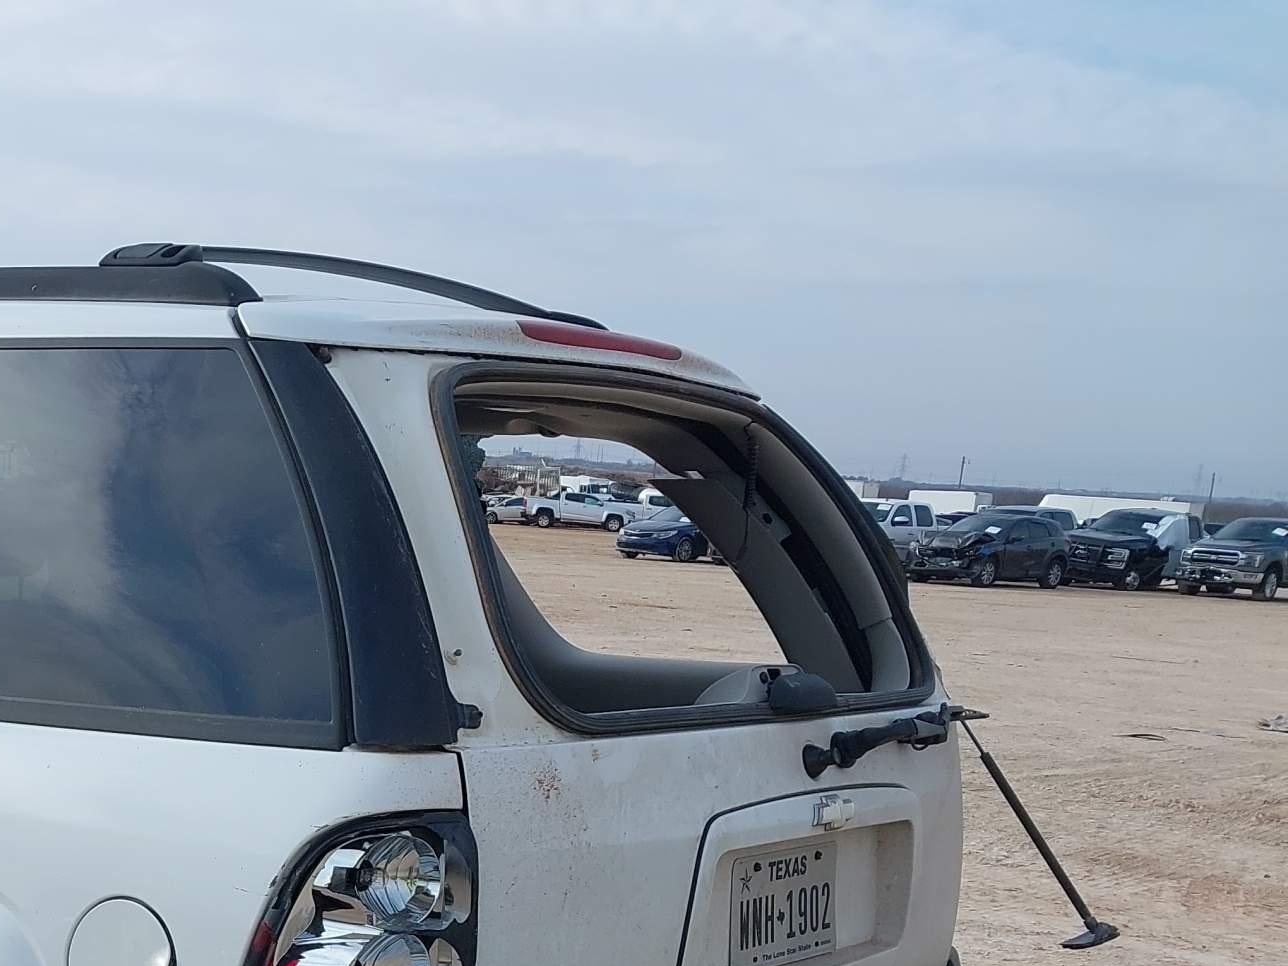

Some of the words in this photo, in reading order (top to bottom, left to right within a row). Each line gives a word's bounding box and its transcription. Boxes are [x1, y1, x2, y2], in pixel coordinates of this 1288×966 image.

[768, 855, 808, 882] TEXAS
[739, 894, 775, 951] WNH
[786, 882, 831, 939] 1902
